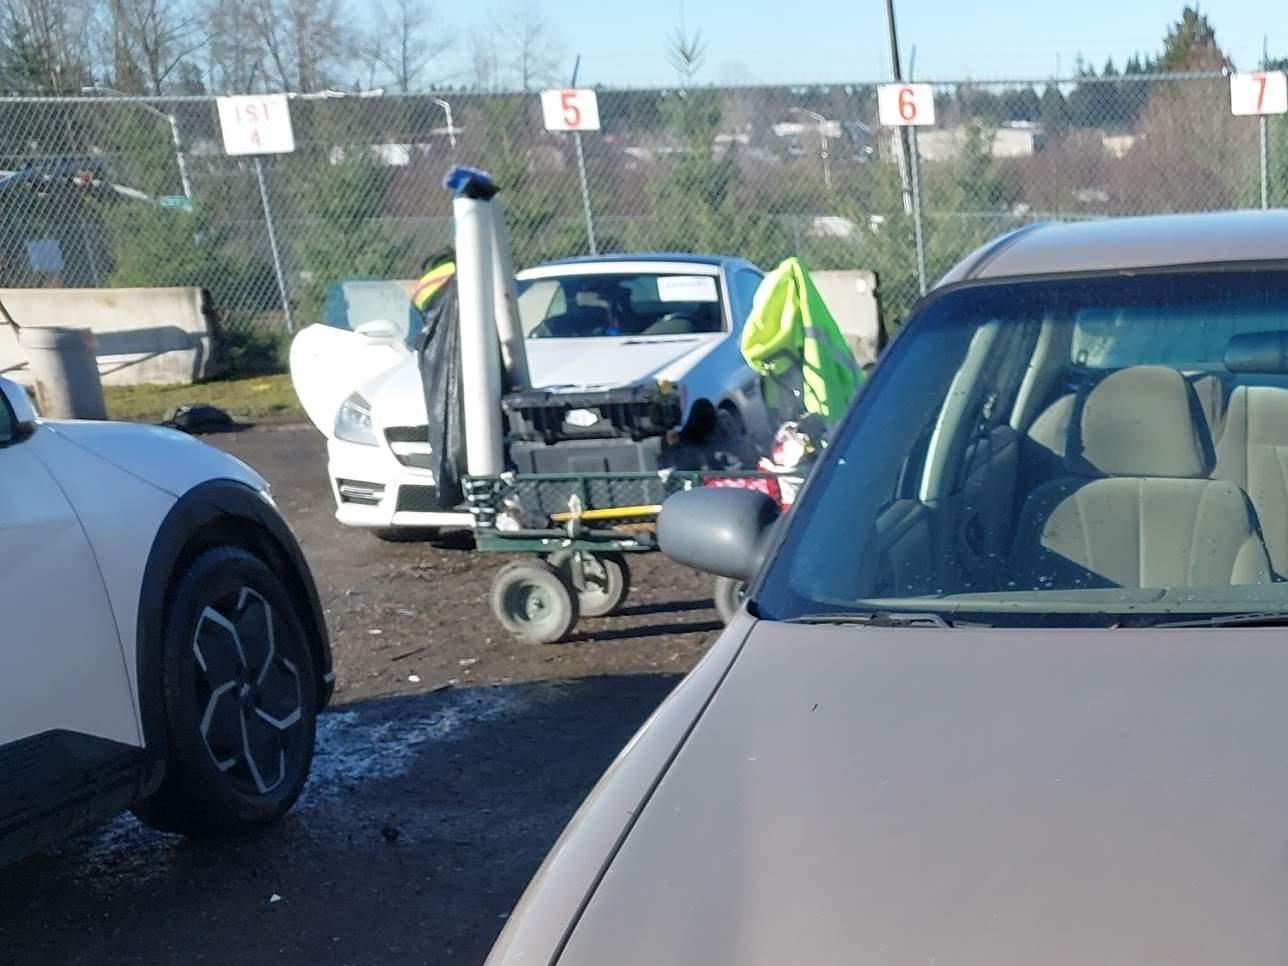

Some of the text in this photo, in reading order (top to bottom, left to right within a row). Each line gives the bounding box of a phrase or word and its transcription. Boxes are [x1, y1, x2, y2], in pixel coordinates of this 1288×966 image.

[560, 90, 581, 128] 5
[898, 86, 917, 124] 6
[1251, 74, 1267, 113] 7
